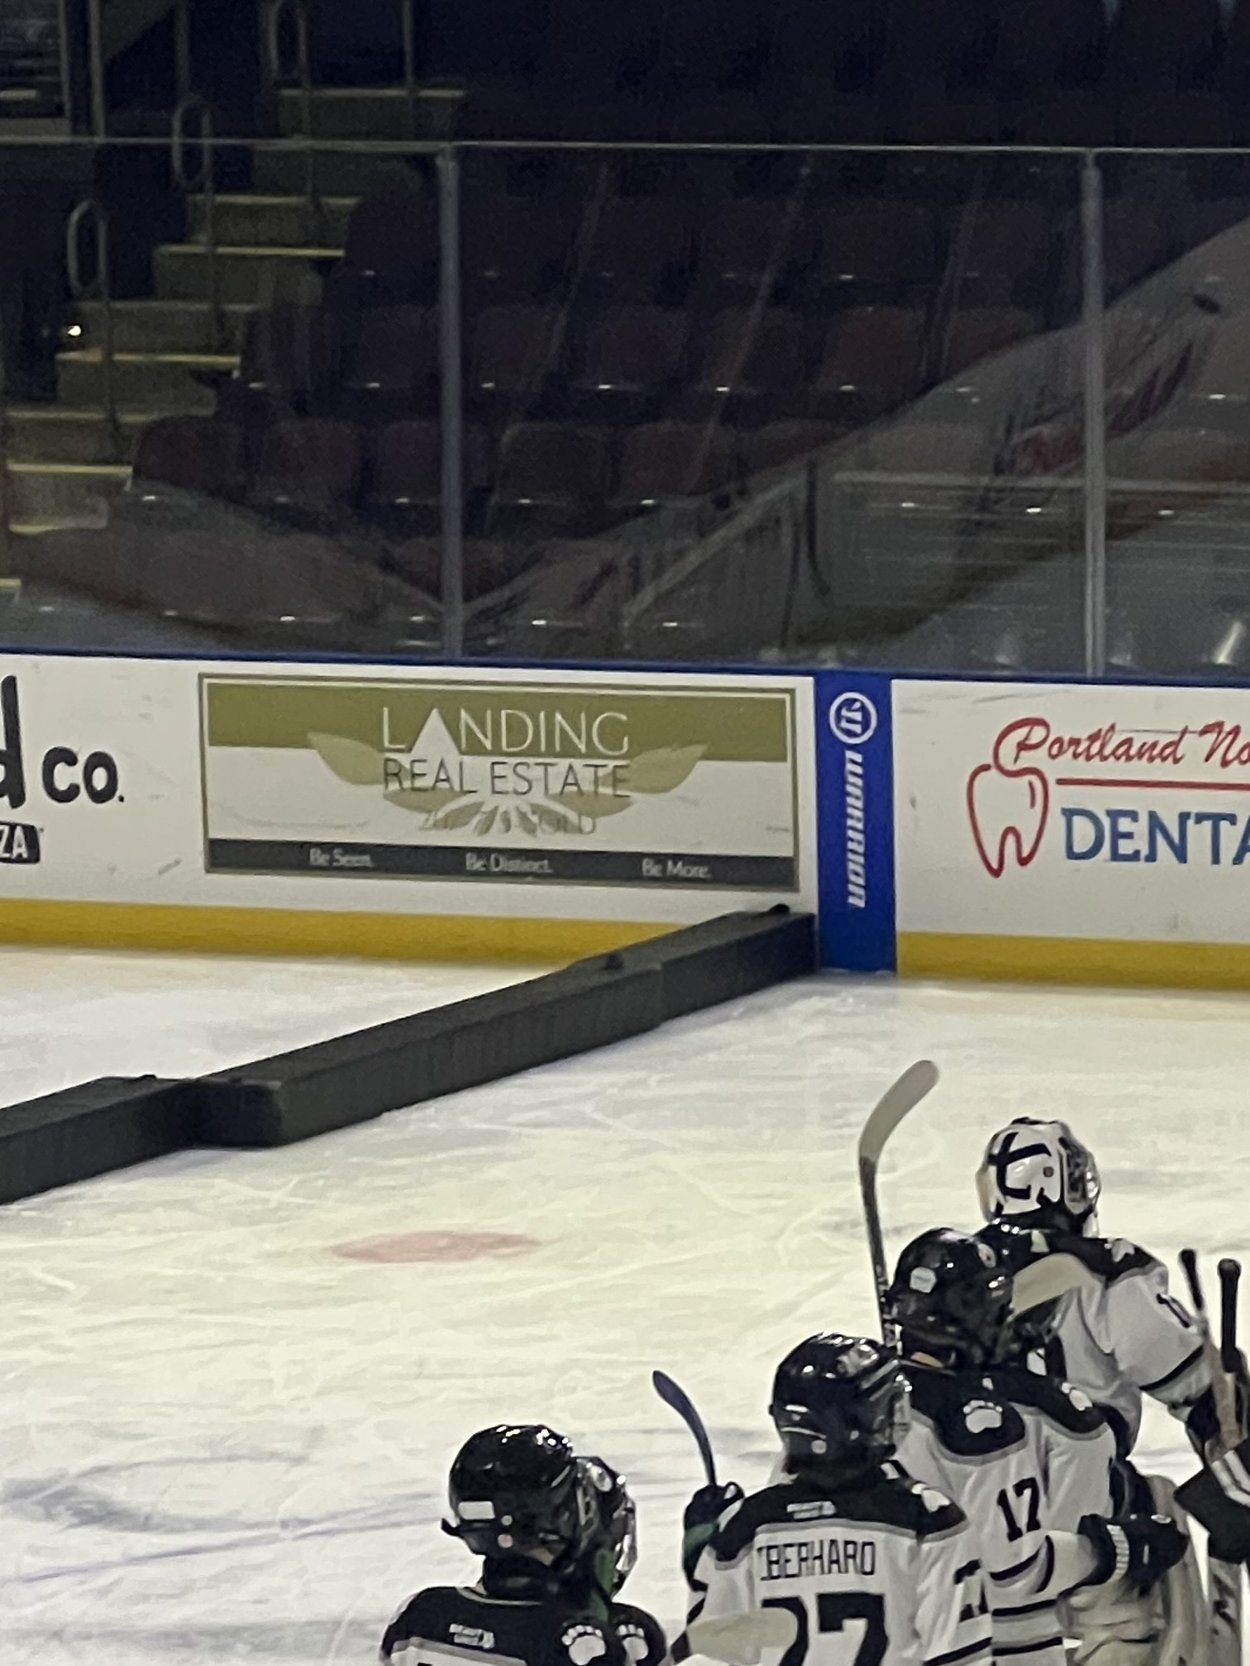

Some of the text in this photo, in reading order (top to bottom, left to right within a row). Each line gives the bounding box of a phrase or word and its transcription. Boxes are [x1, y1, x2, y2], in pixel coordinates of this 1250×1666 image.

[383, 706, 629, 756] LANDING
[996, 717, 1189, 766] Portland
[384, 756, 632, 798] REAL ESTATE
[309, 848, 329, 867] Be
[465, 852, 487, 871] Be
[641, 858, 662, 878] Be
[997, 1476, 1042, 1543] 17
